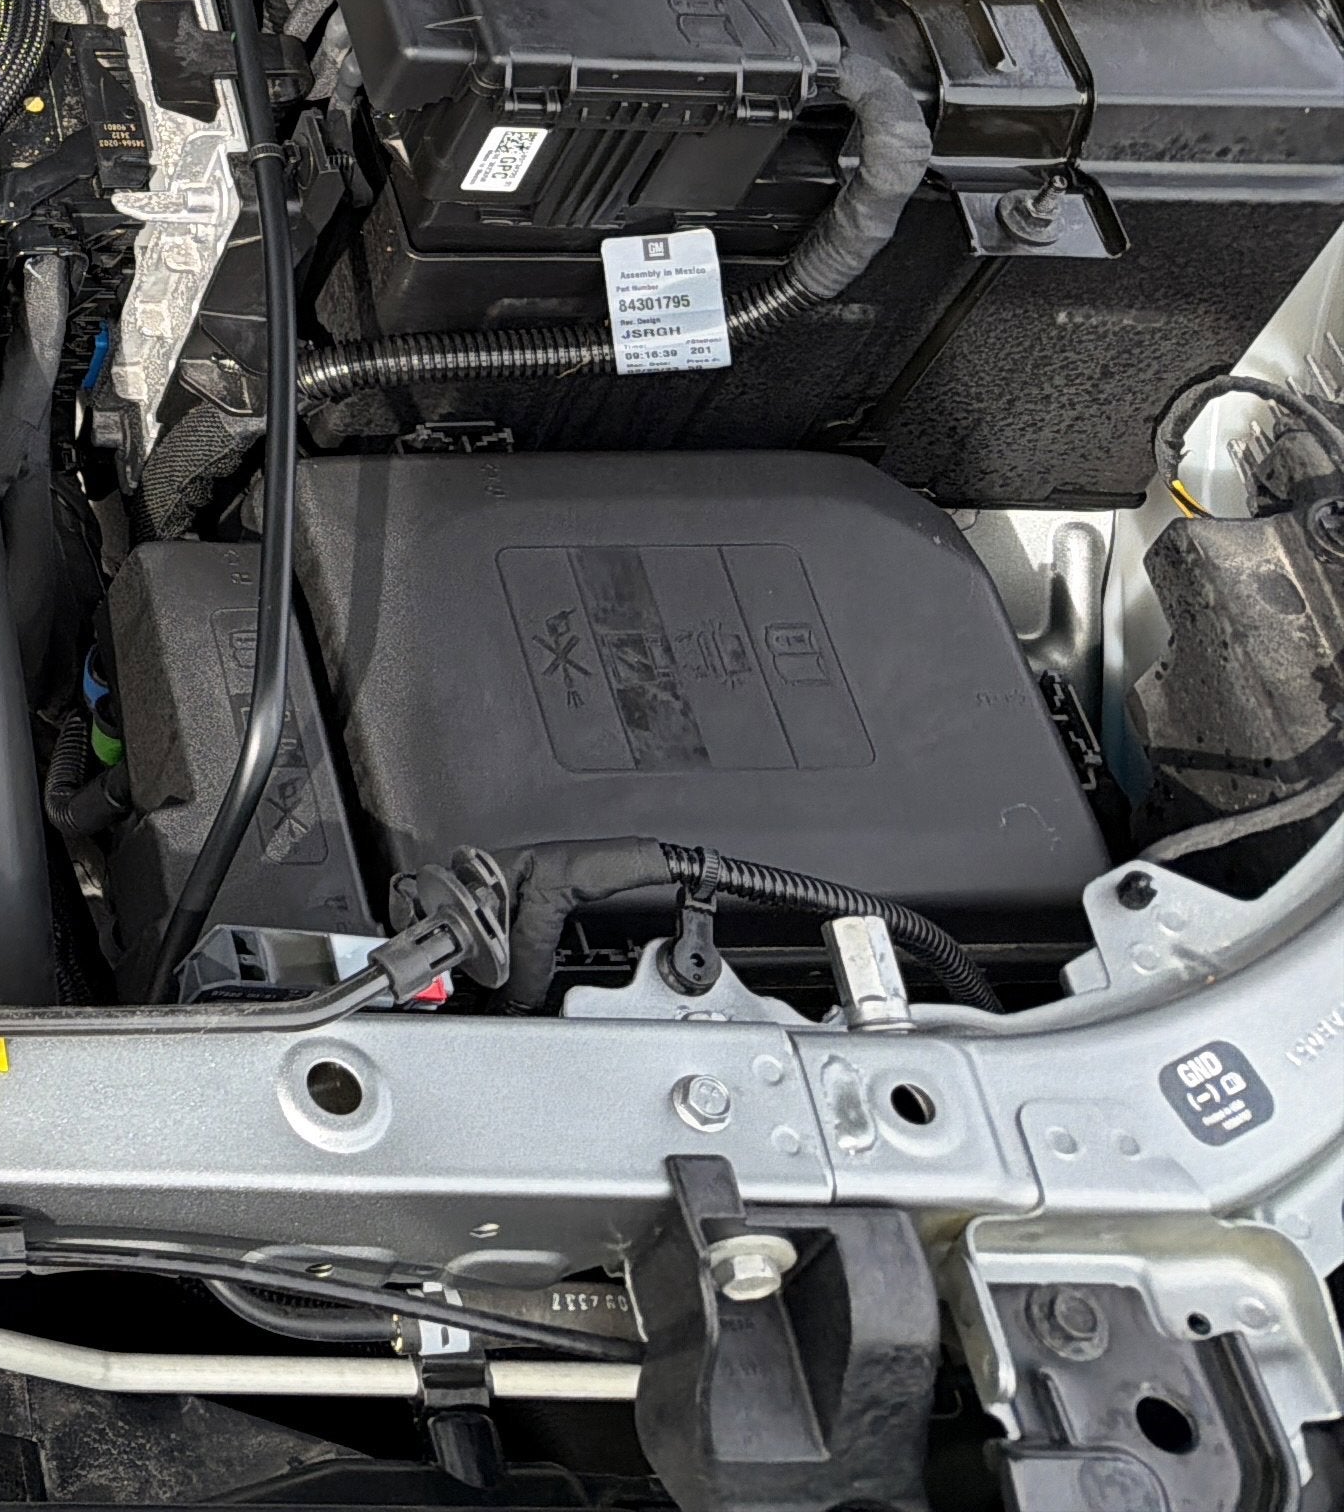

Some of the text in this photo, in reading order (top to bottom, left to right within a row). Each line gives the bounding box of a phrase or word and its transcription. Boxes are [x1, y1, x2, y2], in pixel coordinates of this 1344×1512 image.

[491, 157, 511, 180] GPC
[620, 266, 706, 281] Assembly in Mexico
[619, 294, 691, 313] 84301795
[621, 326, 681, 340] JSRGH
[690, 346, 712, 355] 201
[1177, 1051, 1223, 1088] GND
